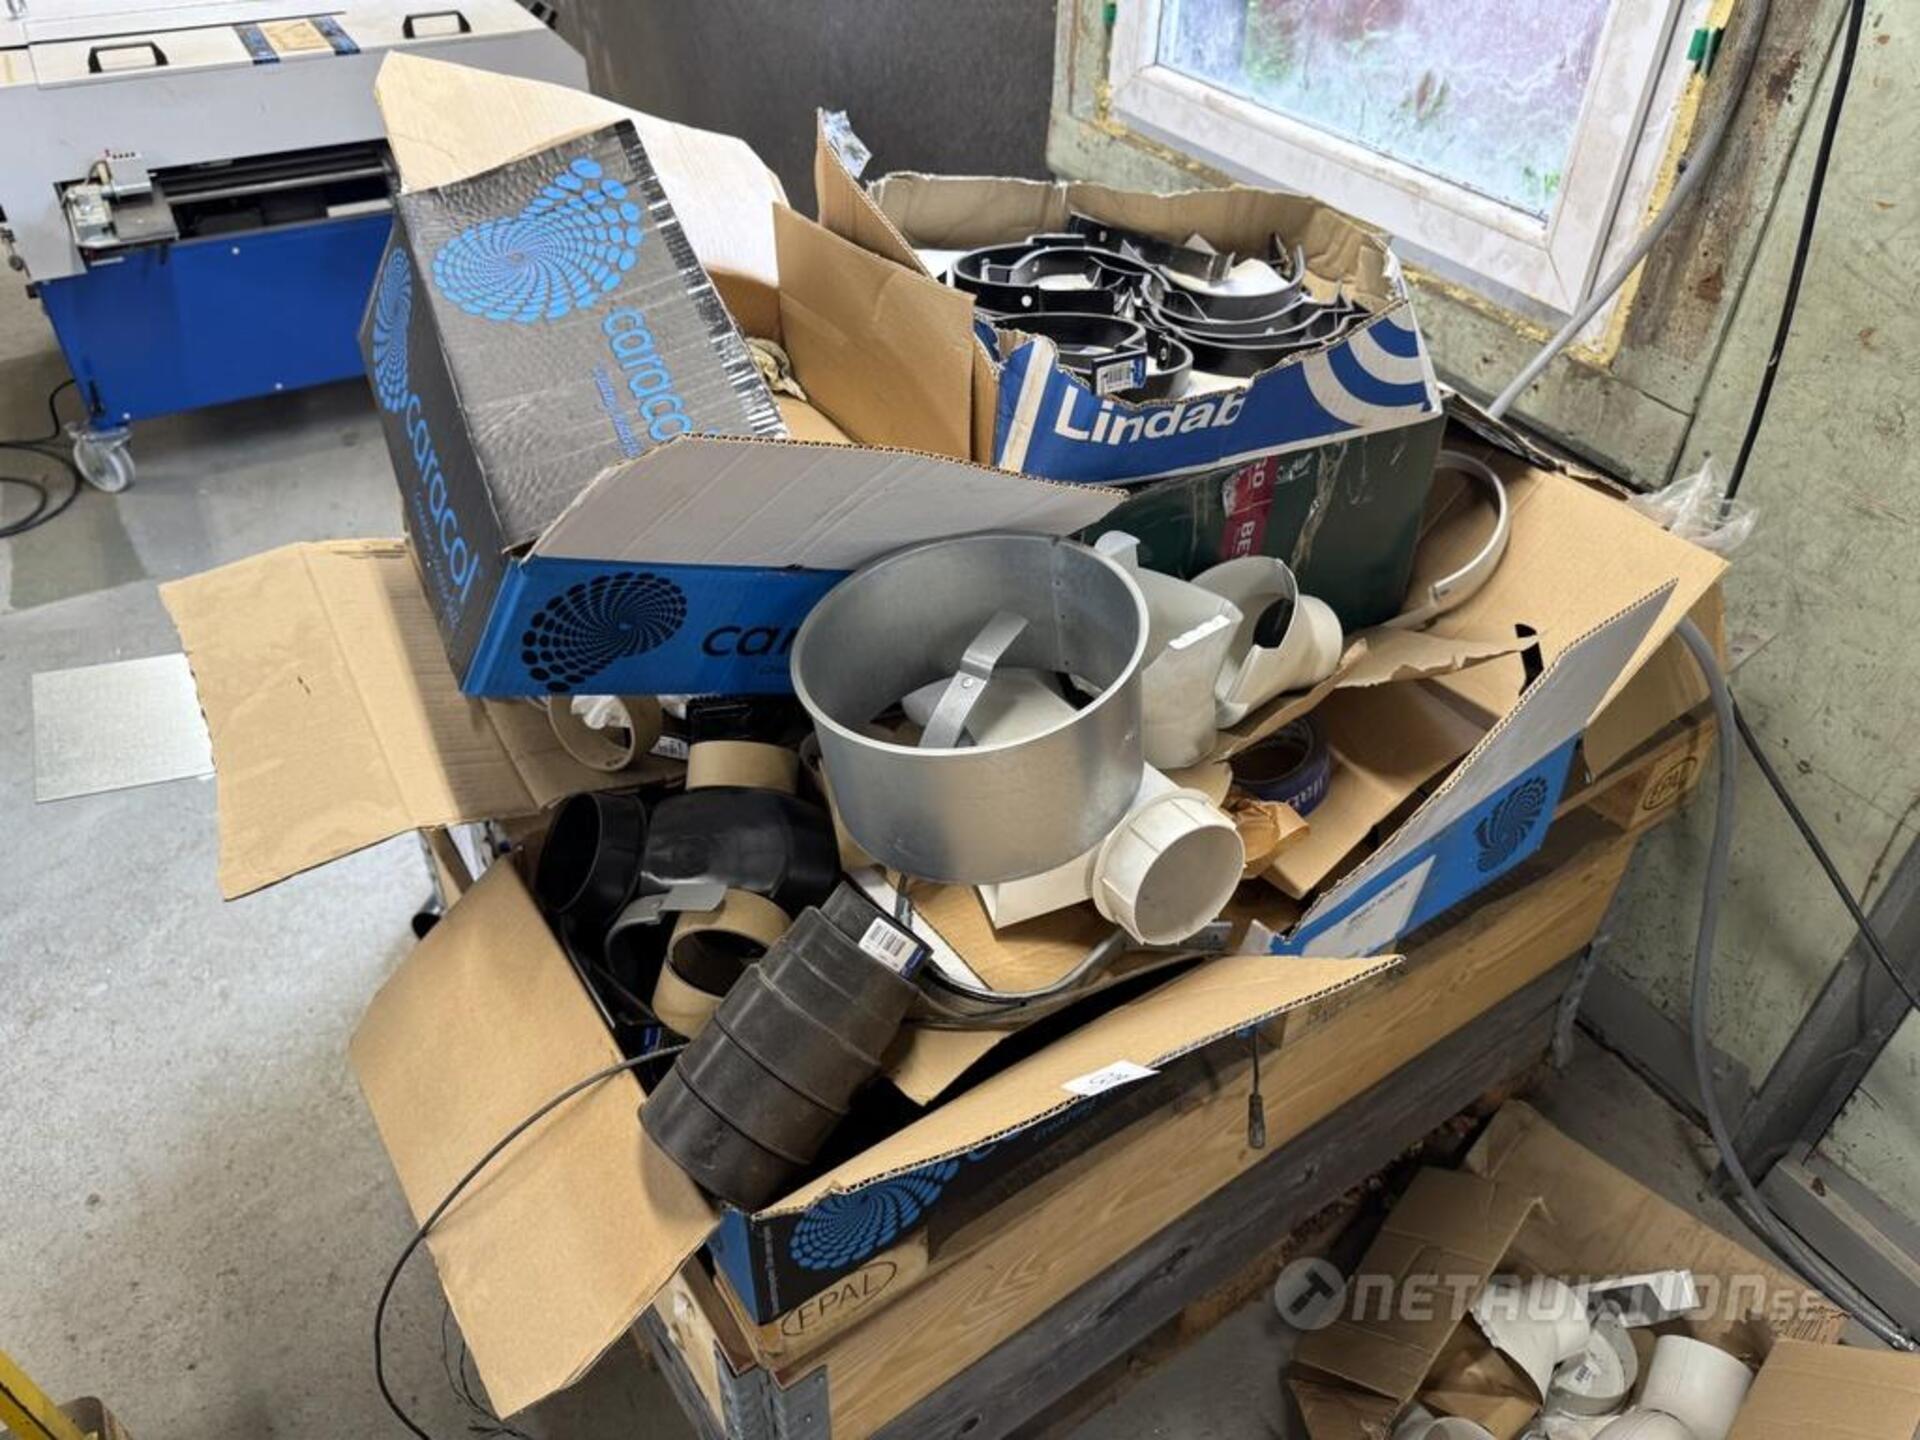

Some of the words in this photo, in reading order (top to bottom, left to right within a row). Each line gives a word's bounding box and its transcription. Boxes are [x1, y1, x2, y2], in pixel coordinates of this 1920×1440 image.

[602, 307, 717, 442] caraco
[1055, 384, 1246, 445] Lindab
[406, 394, 479, 604] caracol
[797, 1272, 881, 1331] EPAL
